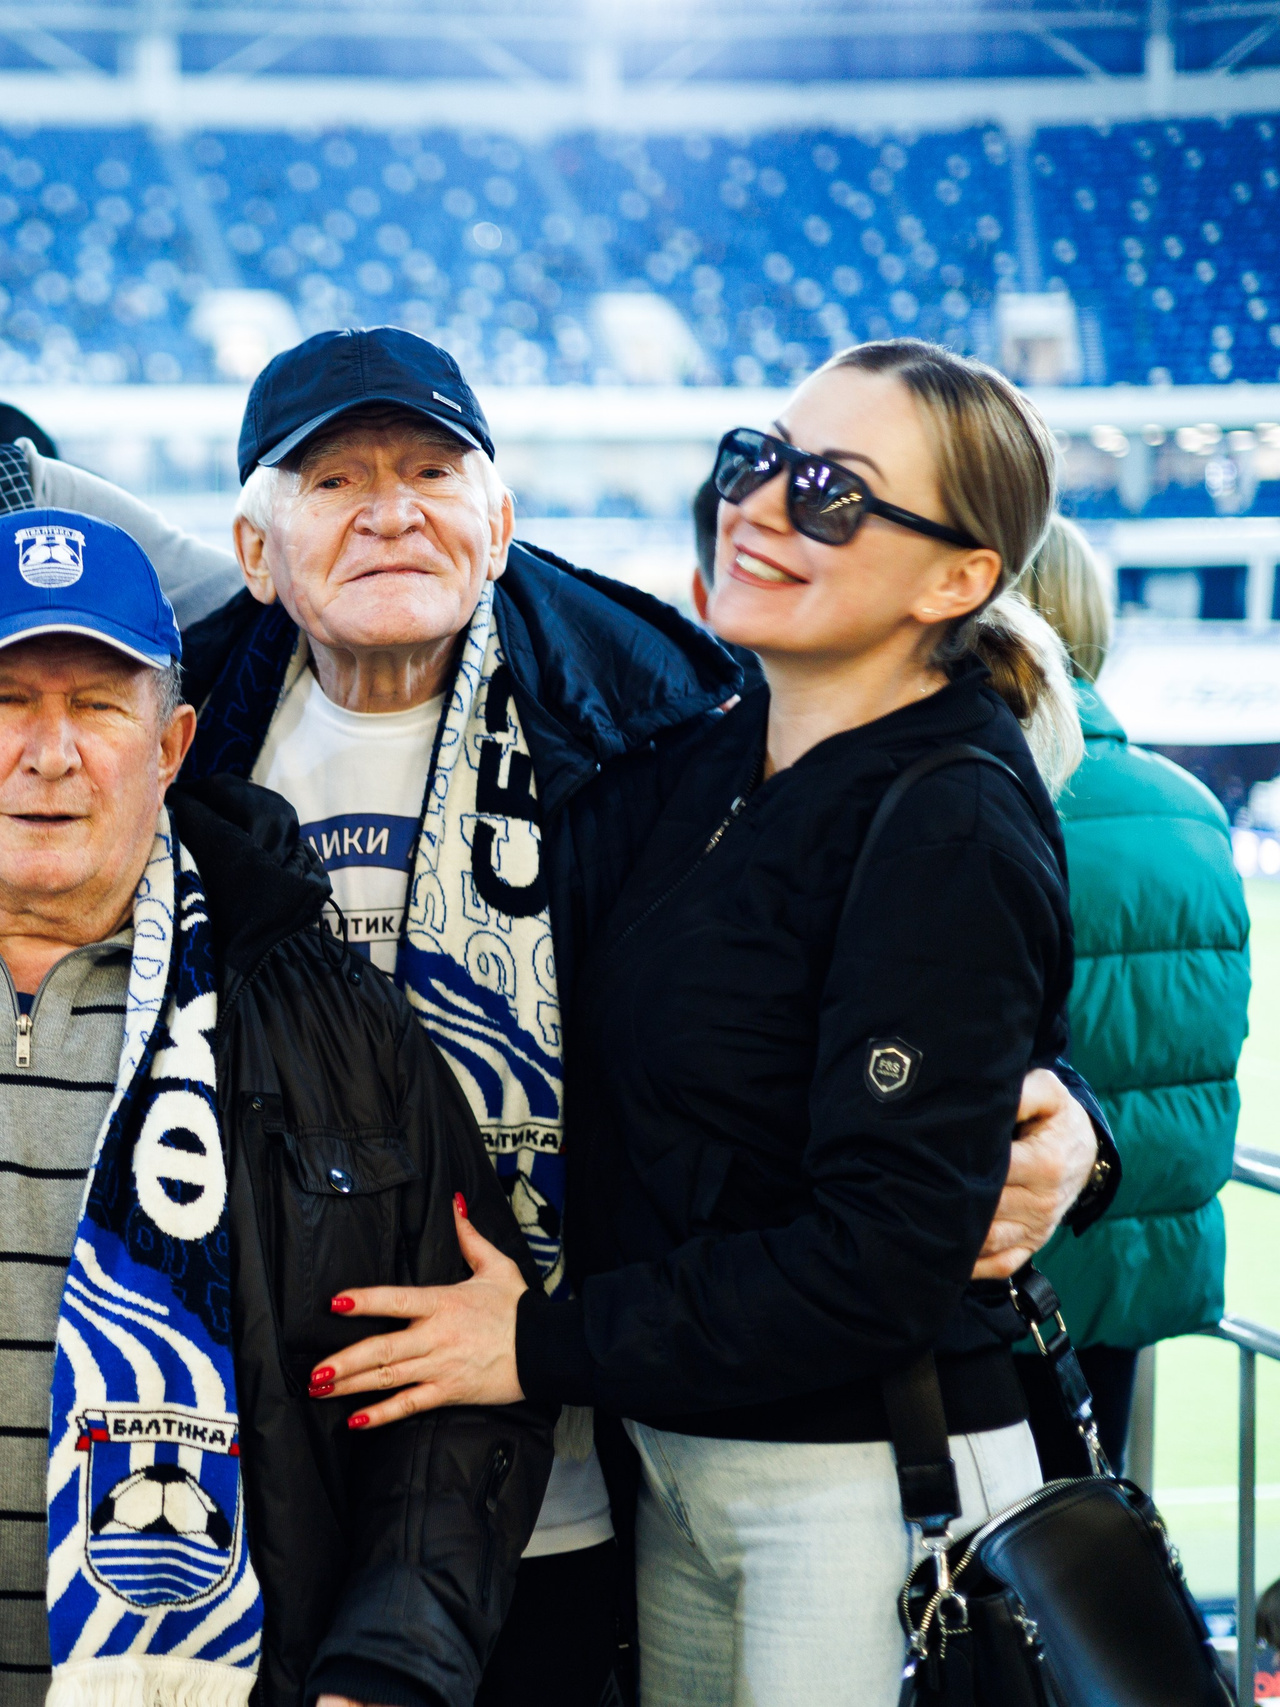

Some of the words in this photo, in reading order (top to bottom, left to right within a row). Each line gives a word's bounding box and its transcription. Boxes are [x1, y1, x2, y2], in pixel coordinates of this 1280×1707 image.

[308, 826, 390, 863] ИКИ
[322, 916, 404, 935] АЛТИК
[113, 1418, 227, 1446] БАЛТИКА
